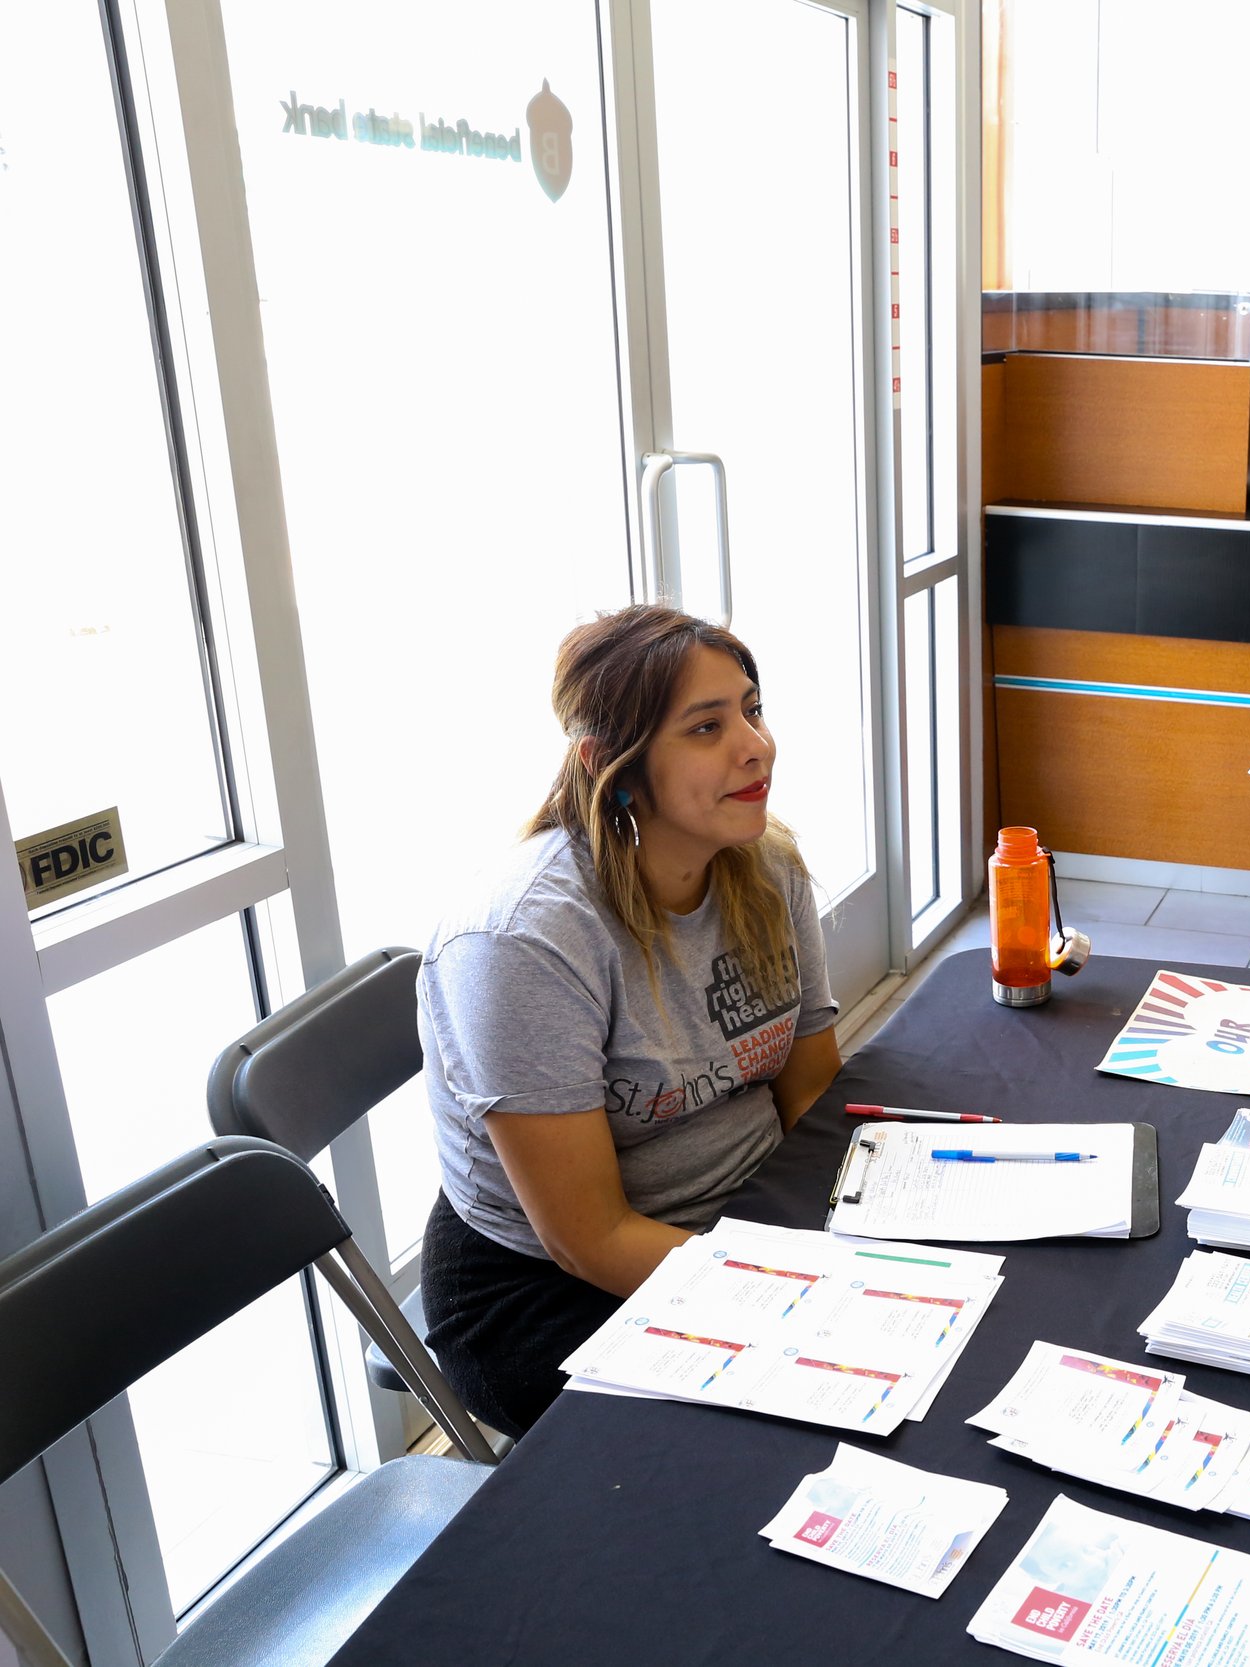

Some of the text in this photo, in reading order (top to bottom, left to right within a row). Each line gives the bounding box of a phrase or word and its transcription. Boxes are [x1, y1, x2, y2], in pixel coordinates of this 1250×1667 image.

[30, 831, 114, 887] FDIC
[731, 1017, 794, 1058] LEADING
[737, 1034, 792, 1071] CHANGE
[740, 1051, 790, 1085] THROU
[605, 1078, 641, 1117] St.
[801, 1527, 812, 1537] END
[812, 1519, 832, 1541] POVERTY
[825, 1539, 837, 1550] SAVE
[835, 1527, 846, 1537] THE
[844, 1513, 856, 1526] DATE
[1024, 1608, 1040, 1624] END
[1034, 1606, 1055, 1627] CHILD
[1045, 1600, 1071, 1630] POVERTY
[1075, 1596, 1113, 1647] SAVE THE DATE
[1161, 1616, 1195, 1666] ESERVA EL DÍA
